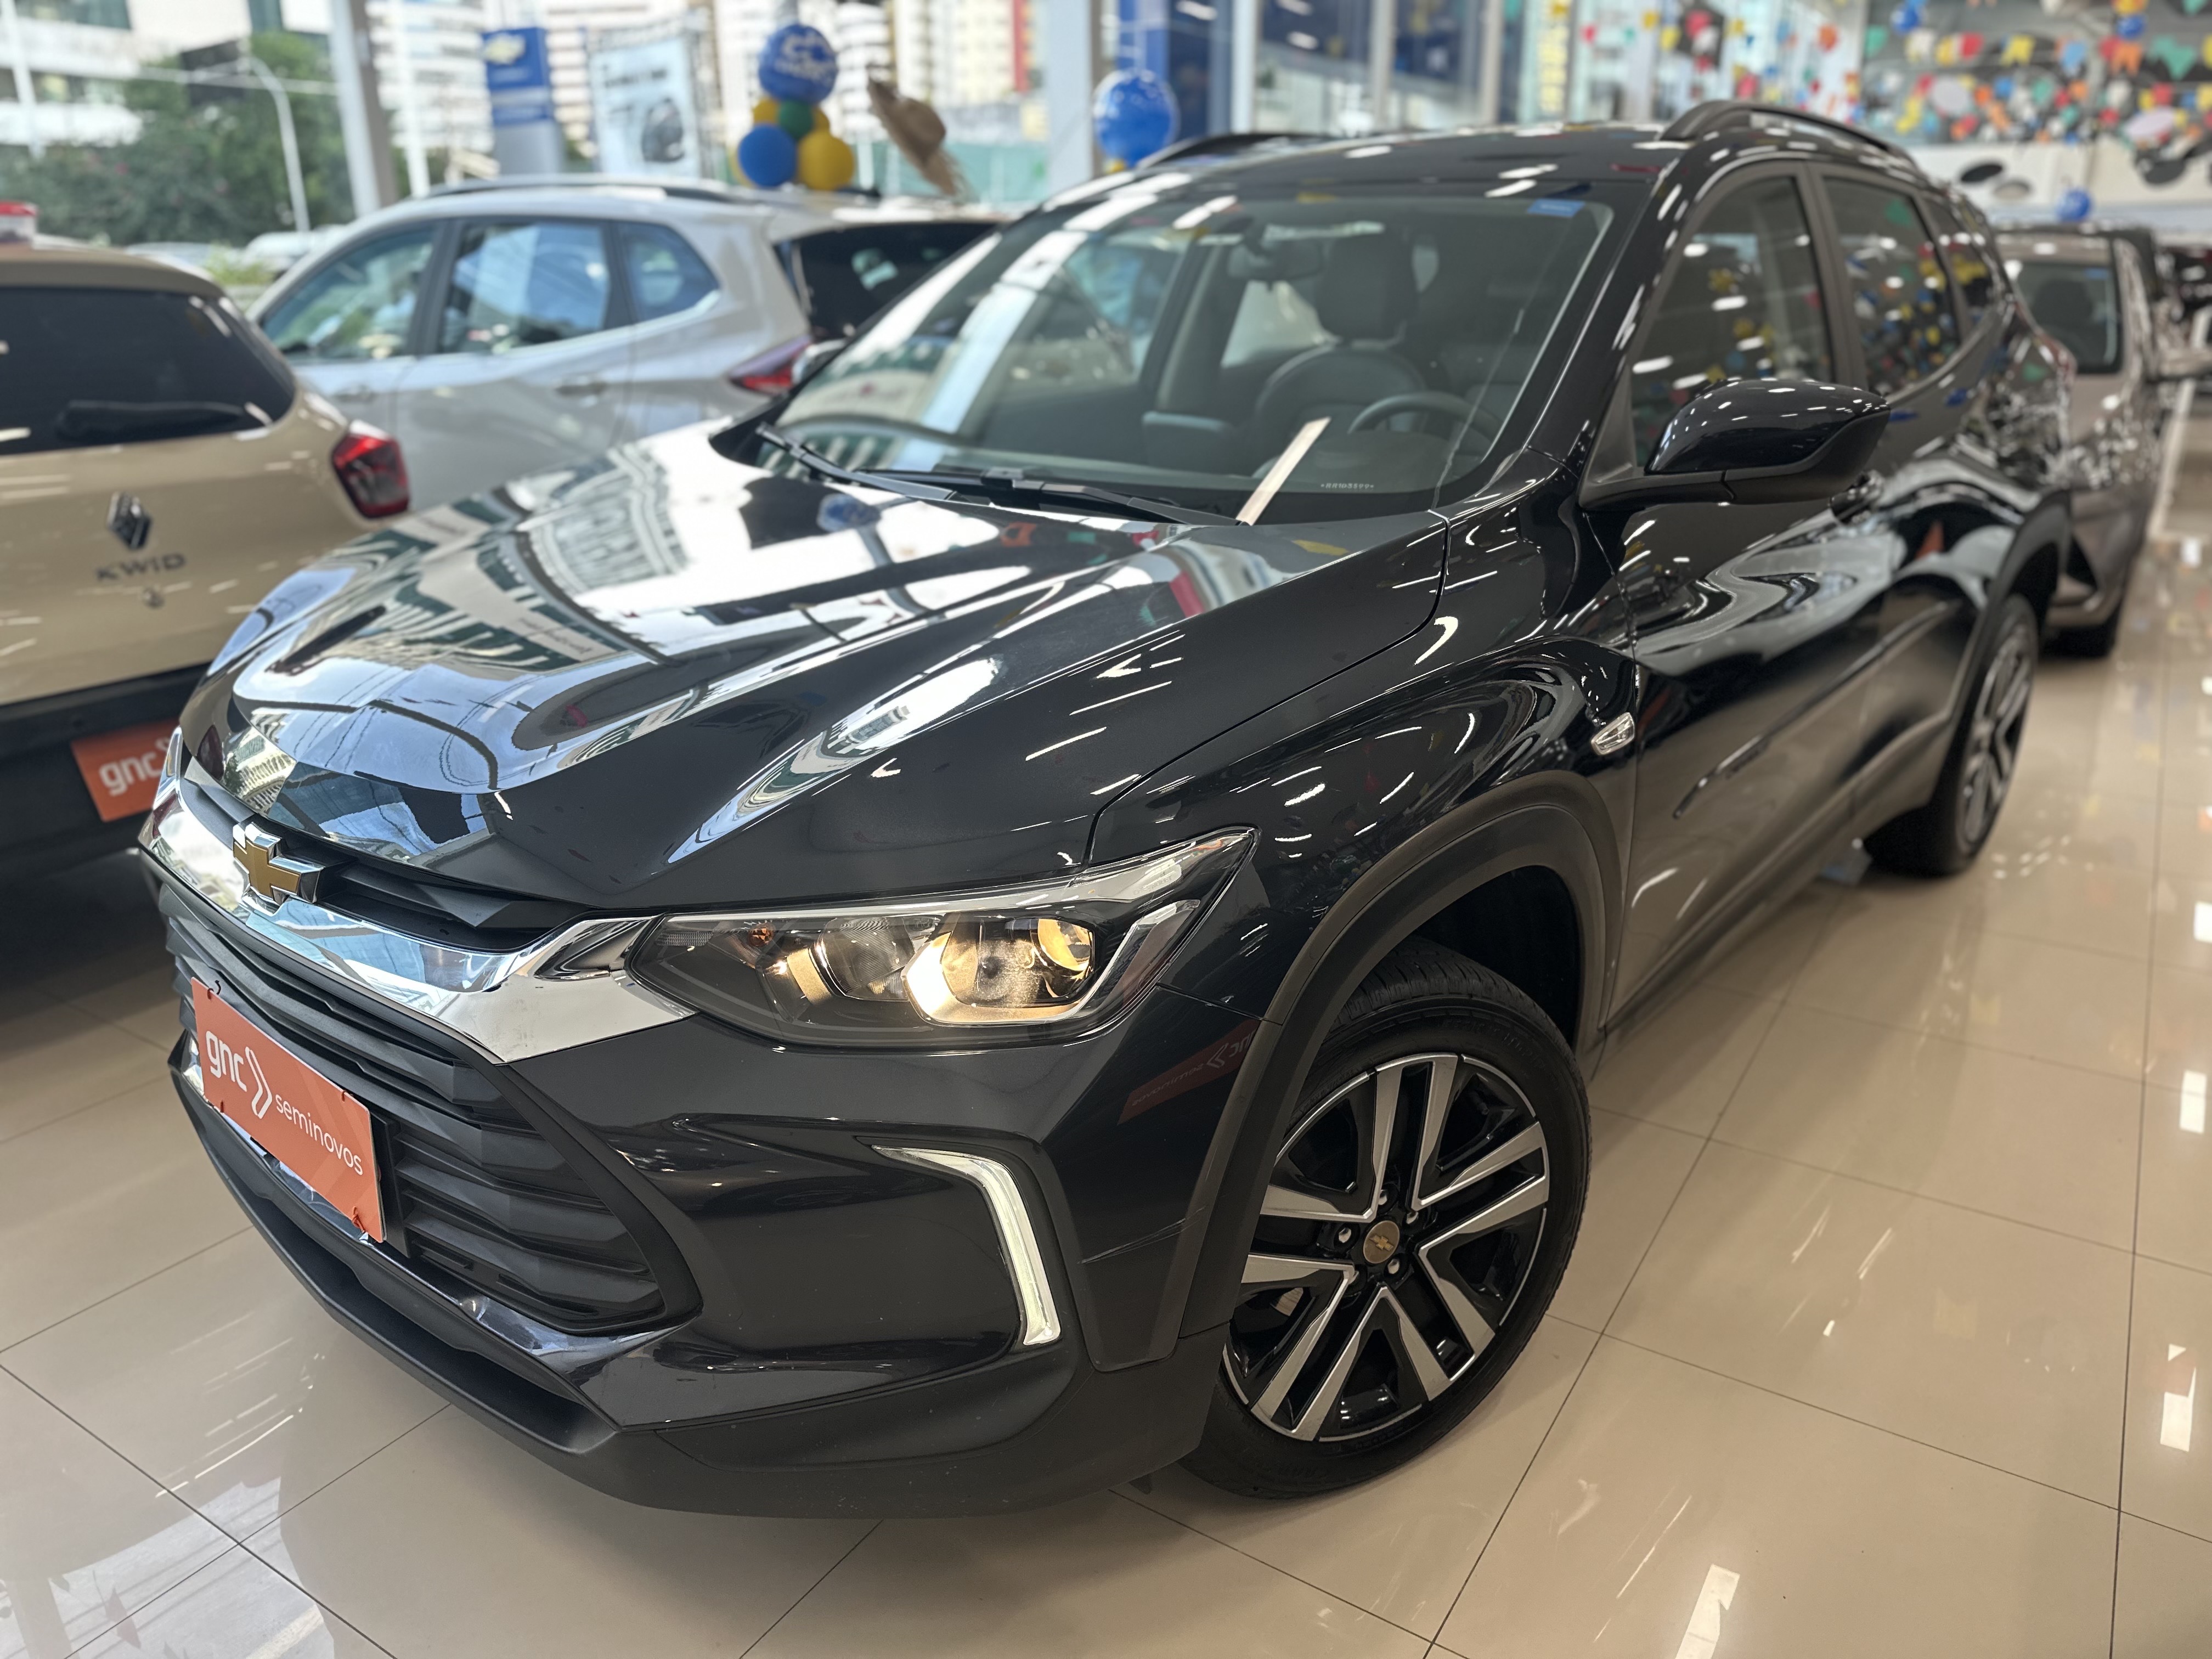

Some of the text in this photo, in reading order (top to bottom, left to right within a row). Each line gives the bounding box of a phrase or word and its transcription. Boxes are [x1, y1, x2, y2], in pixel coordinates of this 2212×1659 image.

[96, 554, 187, 582] KWID
[98, 751, 163, 797] gnc
[206, 1031, 363, 1176] gnc seminovos
